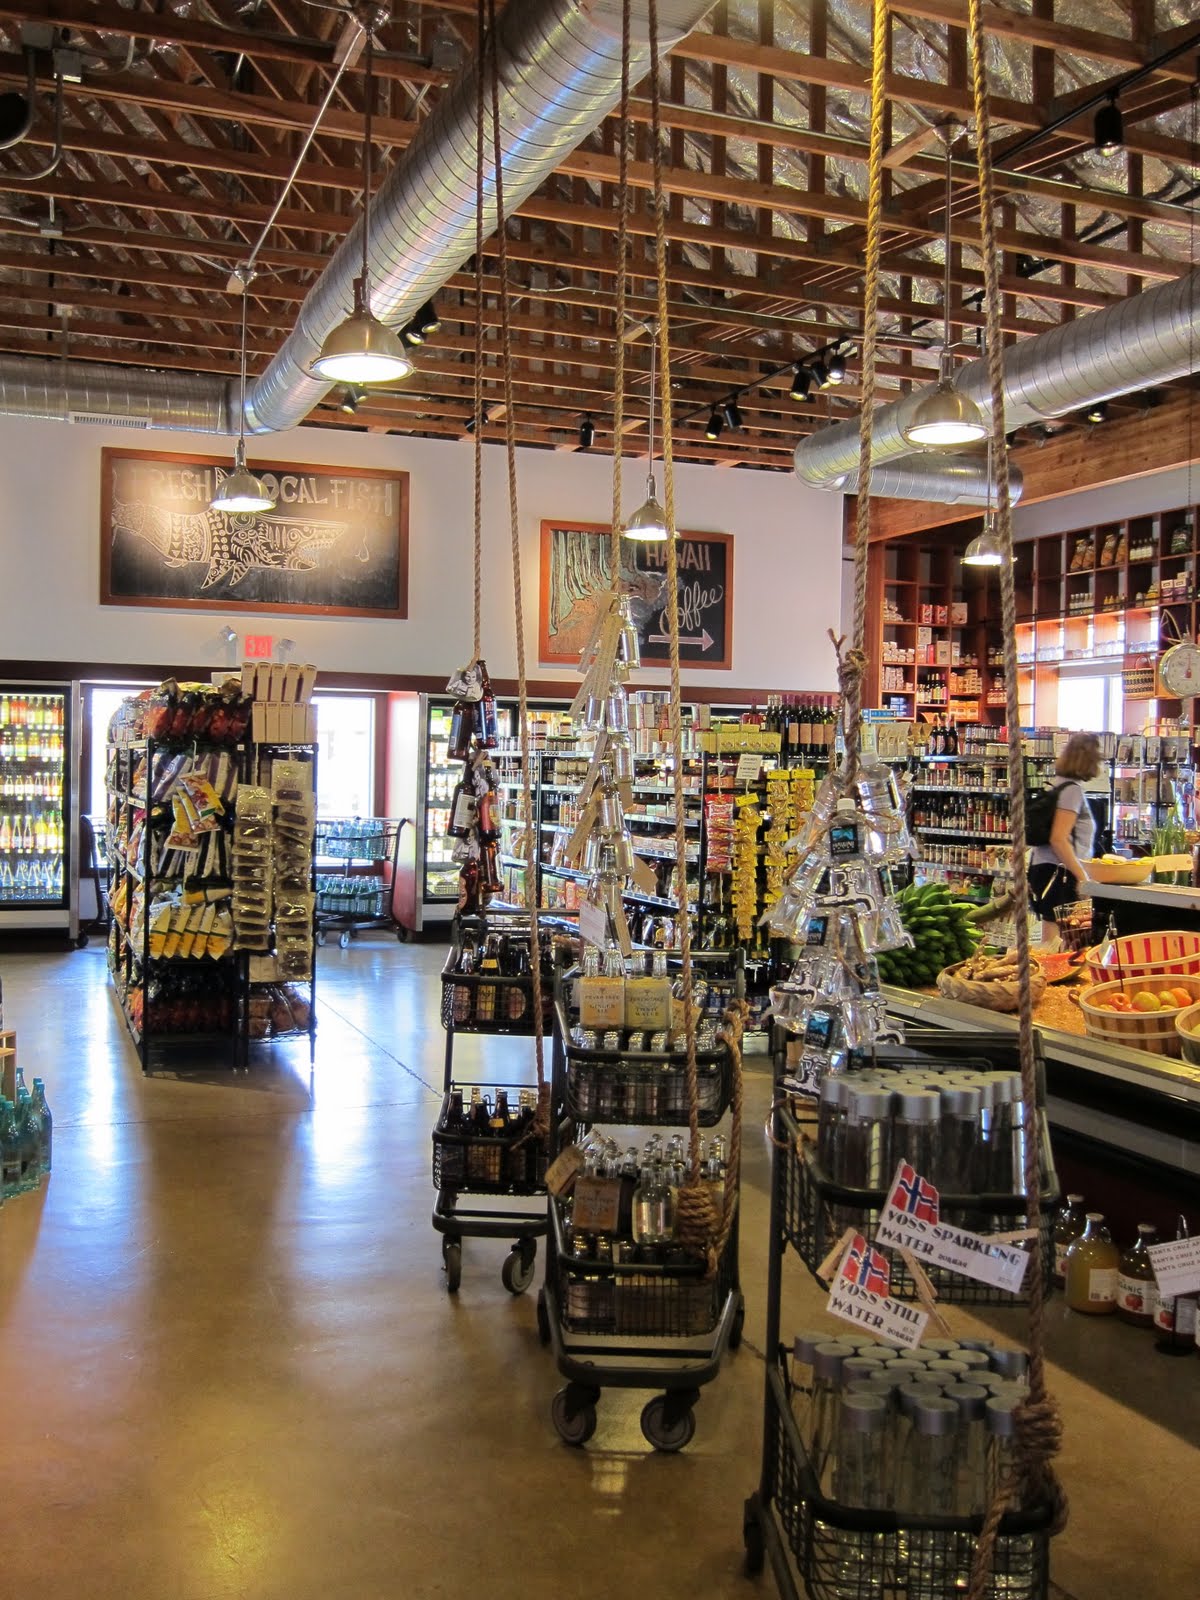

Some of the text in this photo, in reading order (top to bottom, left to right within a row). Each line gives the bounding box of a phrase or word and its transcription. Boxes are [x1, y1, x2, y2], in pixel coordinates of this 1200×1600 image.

[259, 472, 329, 505] OCAL
[329, 478, 393, 517] FISH
[658, 580, 724, 637] Coffee
[887, 1209, 929, 1233] VOSS
[880, 1226, 935, 1257] WATER
[1149, 1247, 1172, 1256] SANTA
[1172, 1242, 1190, 1251] CRUZ
[1152, 1256, 1174, 1264] SANTA
[1175, 1252, 1193, 1260] CRUZ
[1154, 1260, 1195, 1273] SANTA CRUZ
[831, 1297, 885, 1329] WATER
[839, 1278, 921, 1326] VOSS STILL
